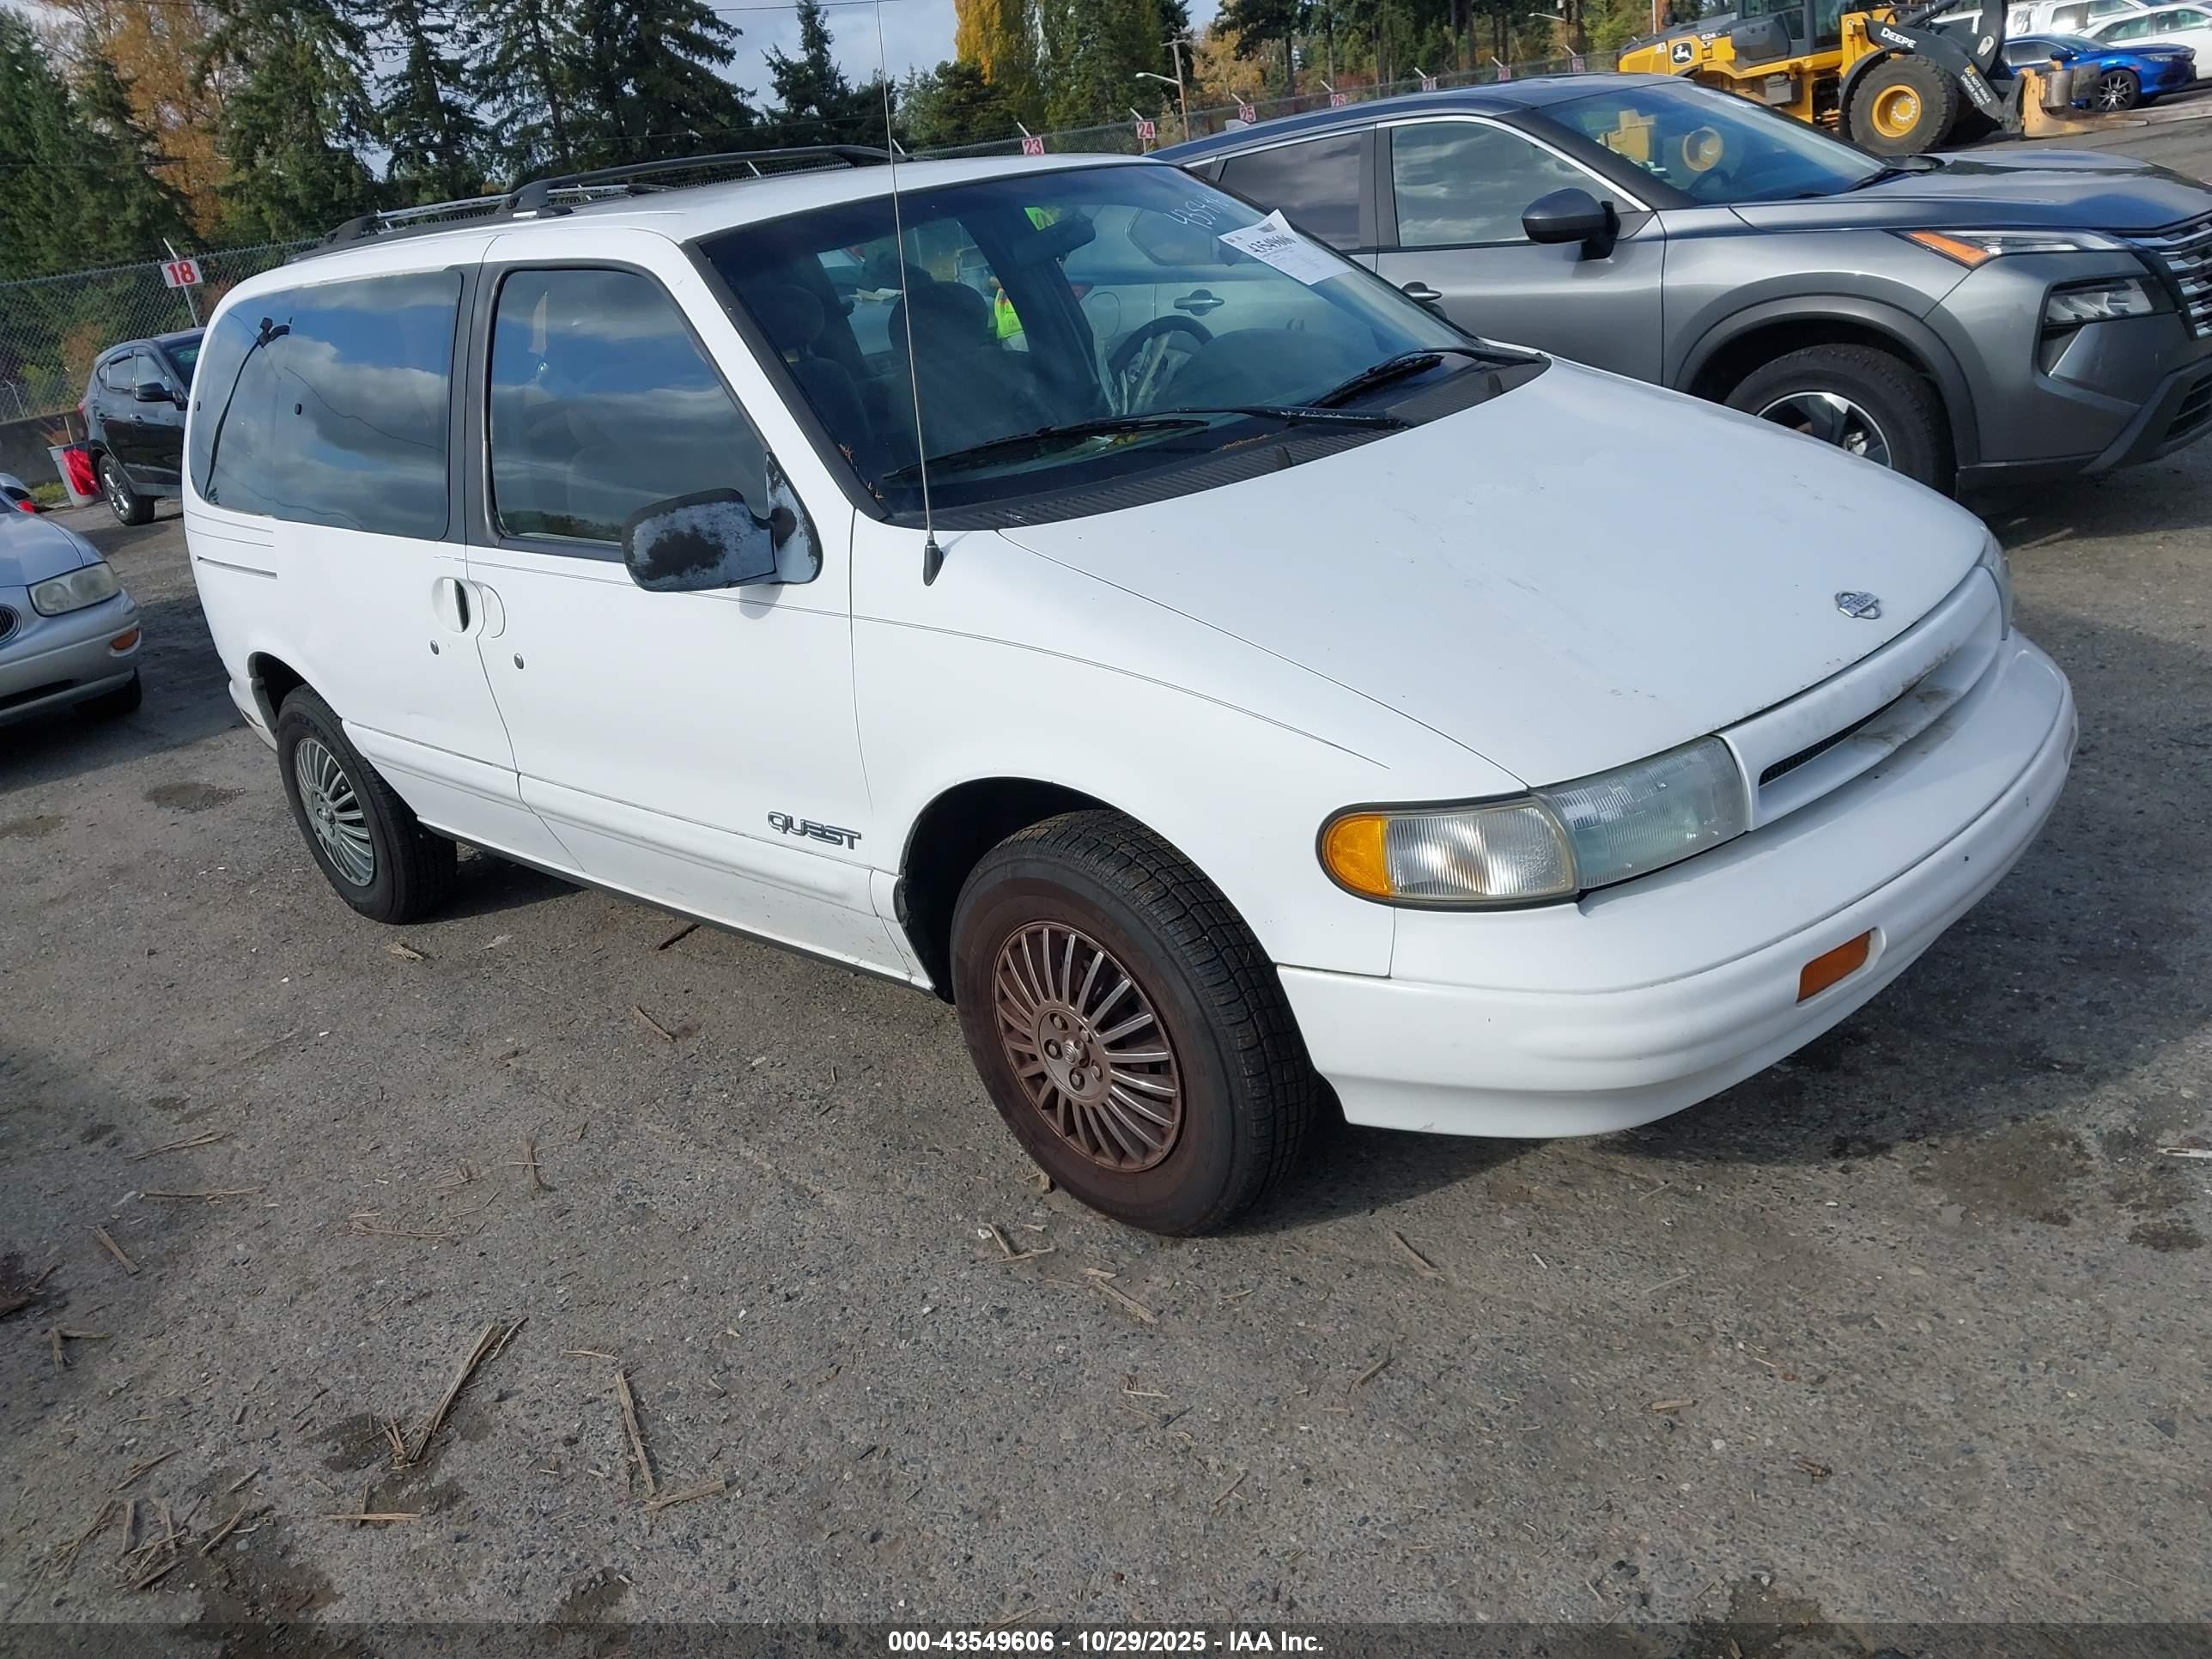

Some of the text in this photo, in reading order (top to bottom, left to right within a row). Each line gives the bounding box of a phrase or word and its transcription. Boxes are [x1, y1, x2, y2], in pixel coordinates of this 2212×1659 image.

[1971, 76, 1982, 88] NOT
[1978, 87, 1992, 104] WALK
[1241, 106, 1255, 120] 25
[1139, 122, 1154, 137] 24
[1024, 139, 1042, 155] 23
[167, 261, 196, 285] 18
[768, 811, 862, 849] QUEST
